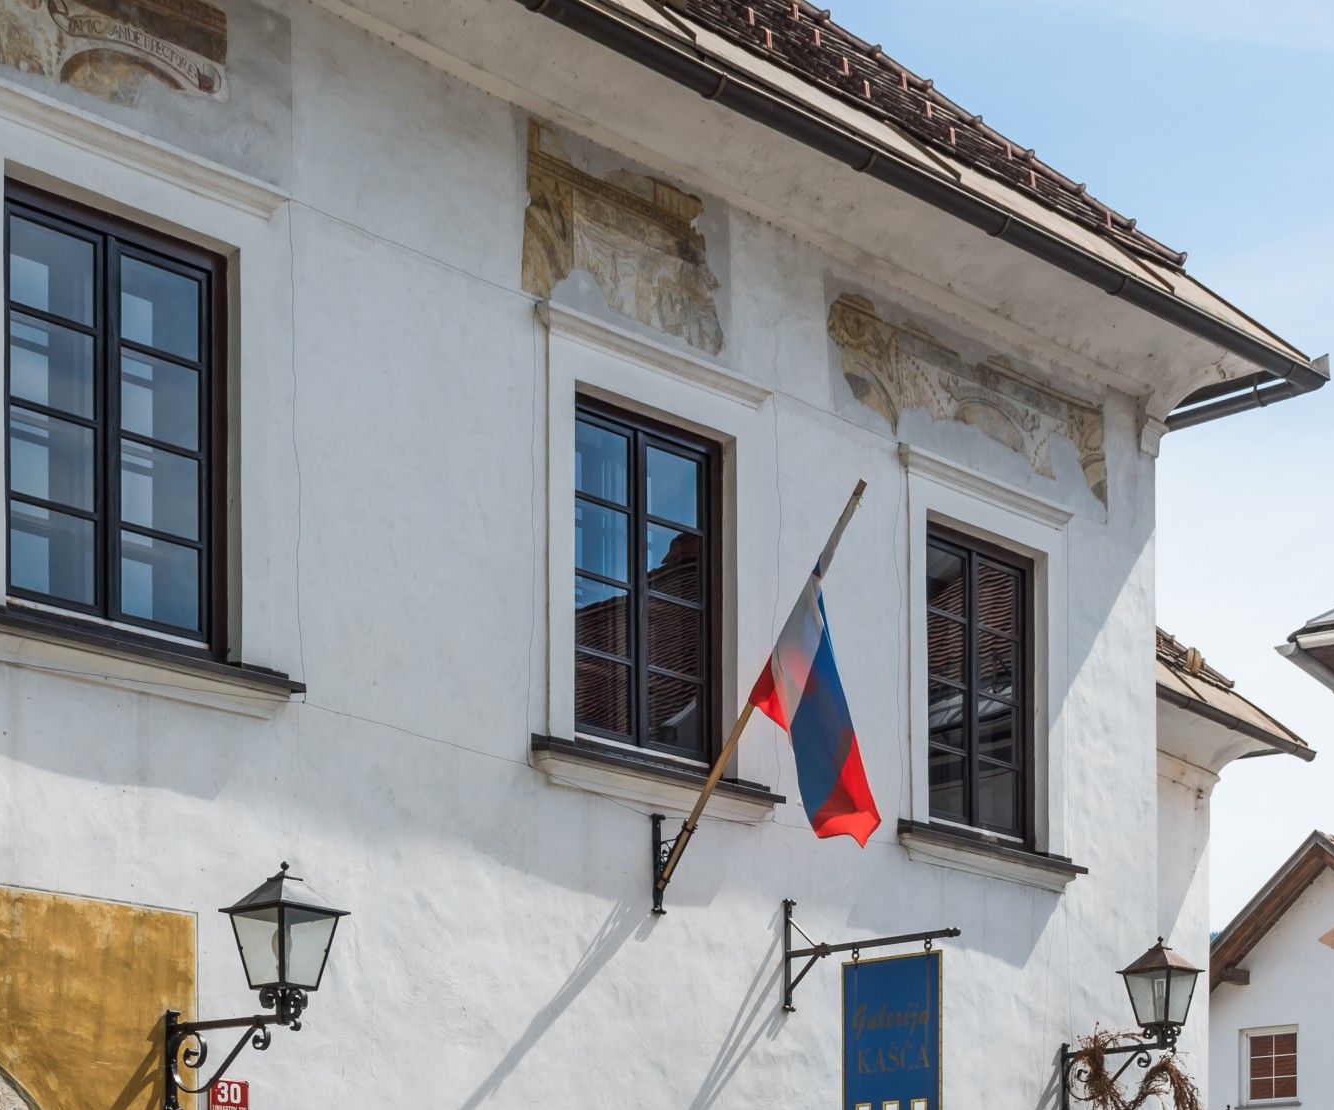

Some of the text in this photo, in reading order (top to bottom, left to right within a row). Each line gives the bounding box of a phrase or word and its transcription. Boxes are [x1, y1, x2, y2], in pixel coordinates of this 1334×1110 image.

[852, 1000, 929, 1040] Galerija
[857, 1041, 930, 1074] KAŠČA
[217, 1082, 241, 1104] 30
